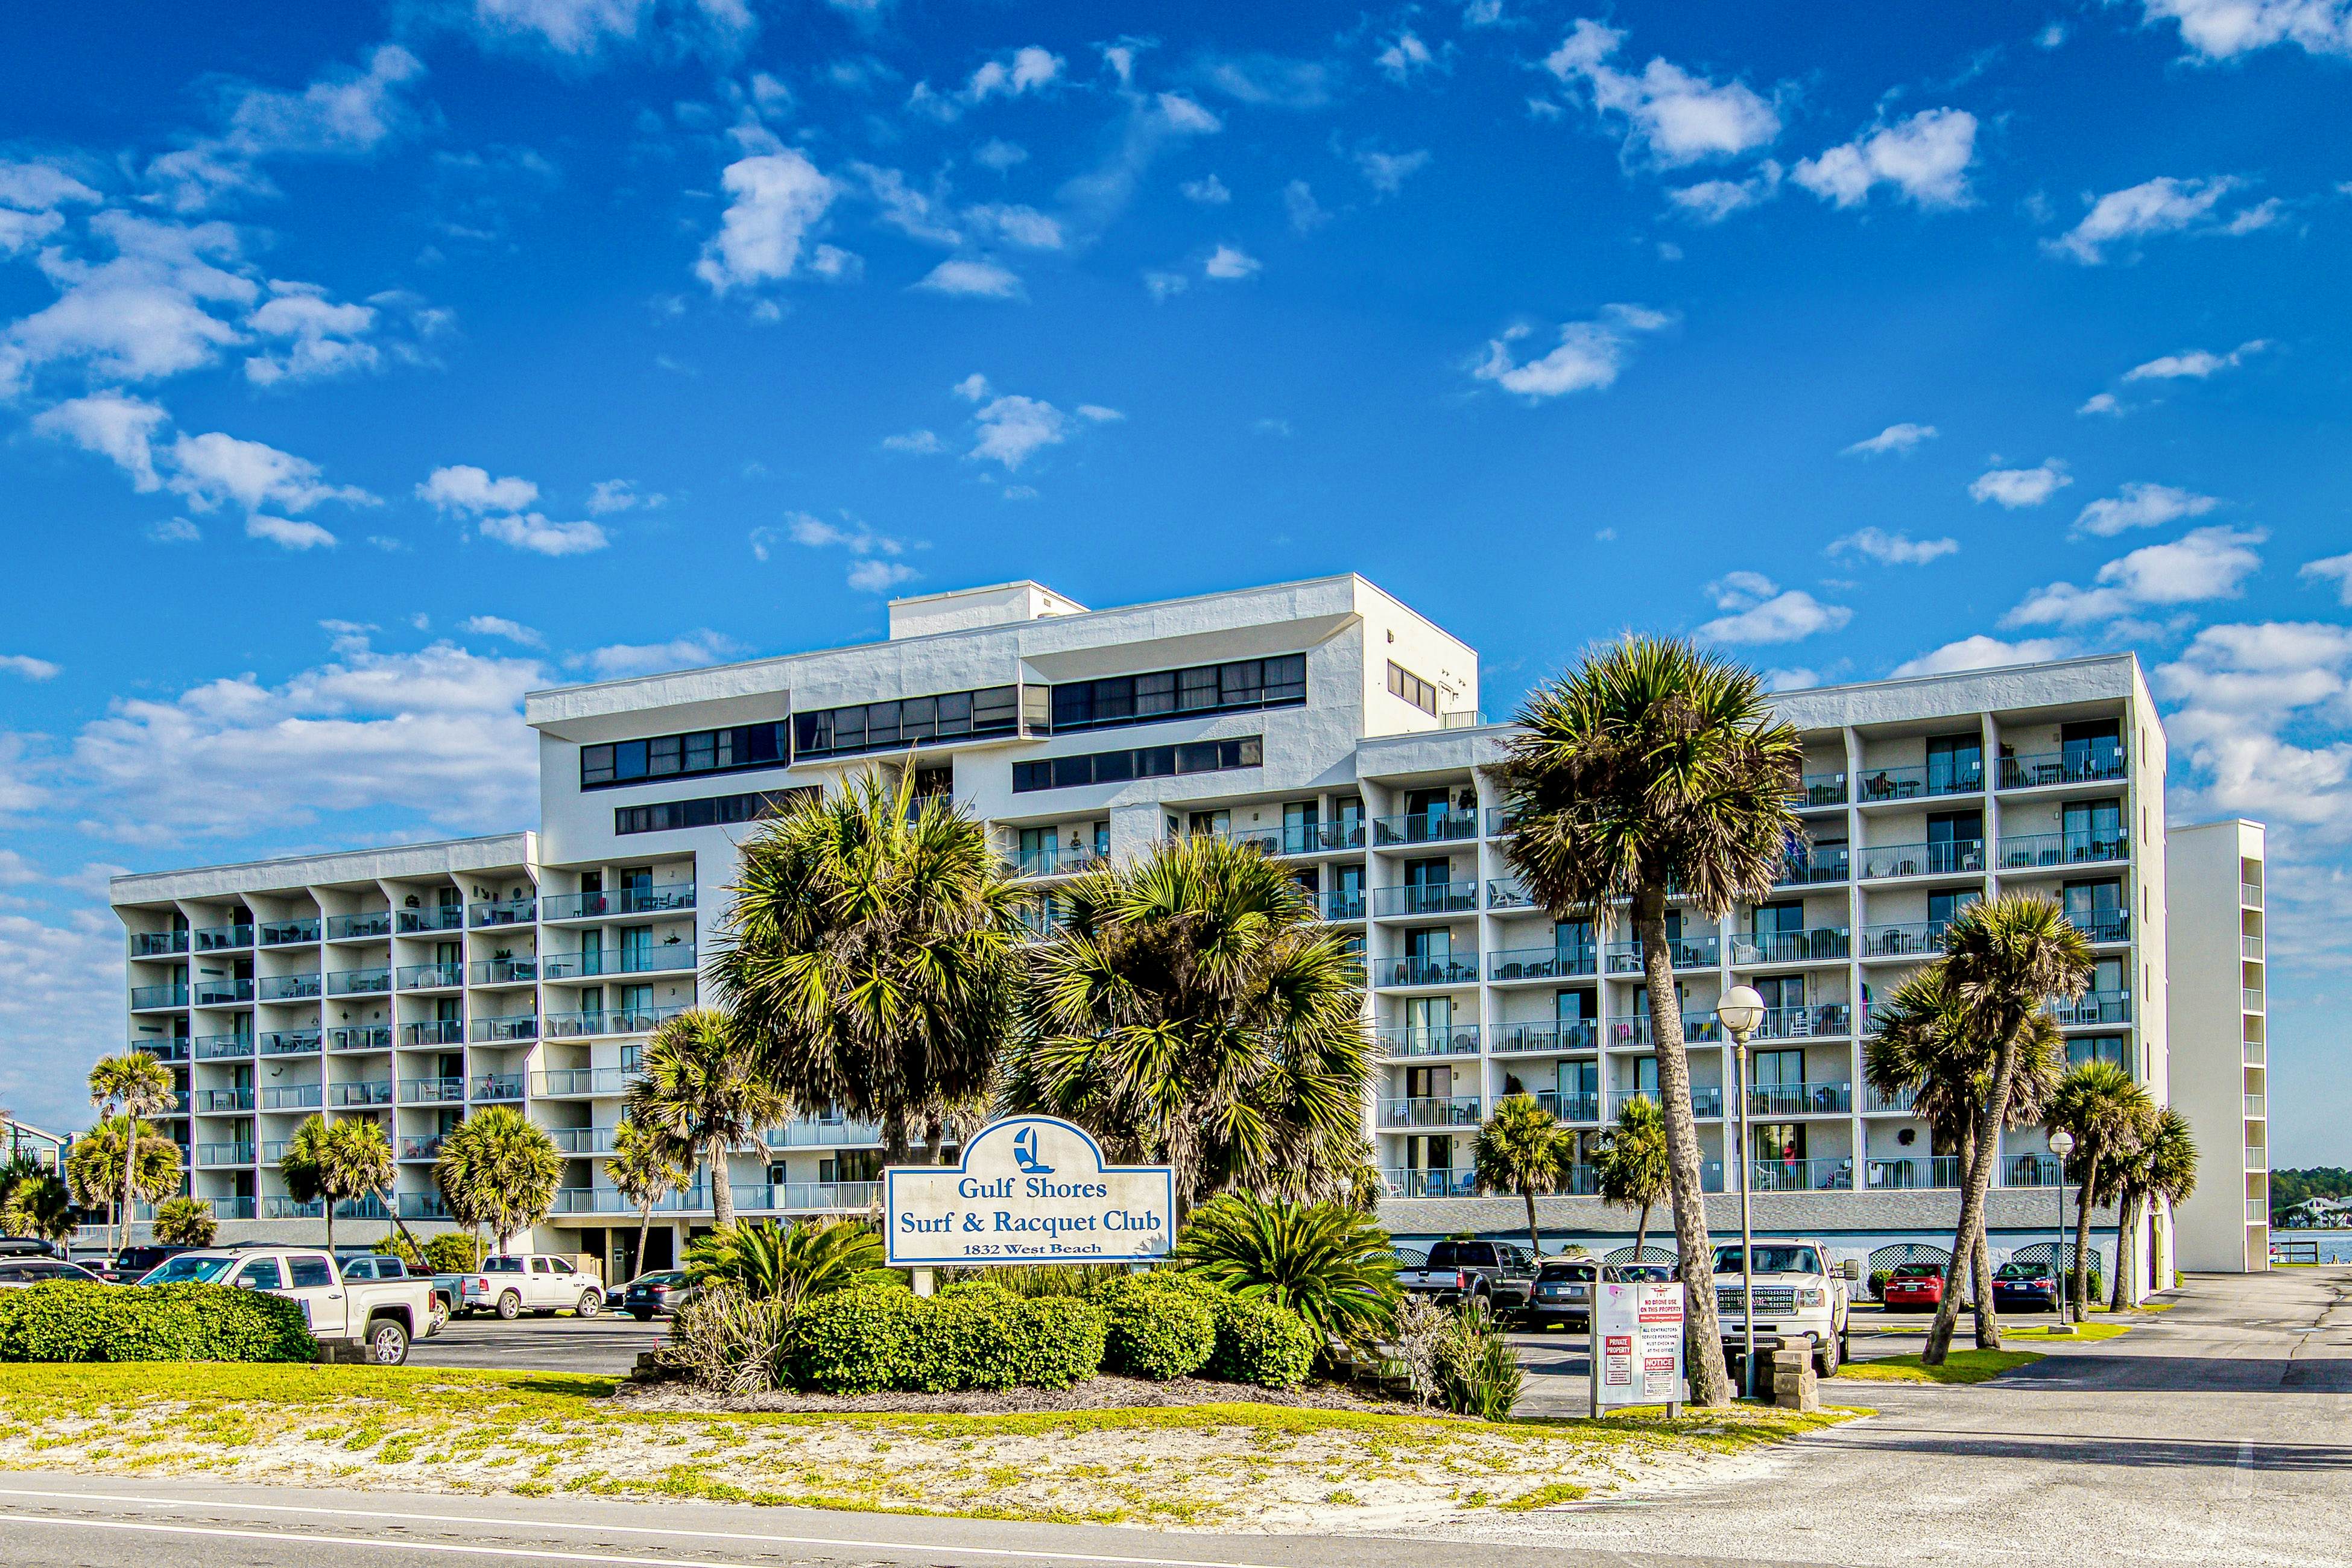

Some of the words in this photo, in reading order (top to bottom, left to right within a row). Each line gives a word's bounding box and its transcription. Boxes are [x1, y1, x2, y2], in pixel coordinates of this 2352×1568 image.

[958, 1177, 1016, 1198] Gulf
[1026, 1177, 1107, 1198] Shores
[901, 1212, 955, 1233] Surf
[963, 1213, 985, 1231] &
[993, 1211, 1096, 1238] Racquet
[1103, 1210, 1161, 1230] Club
[963, 1245, 1000, 1255] 1832
[1004, 1244, 1045, 1254] West
[1049, 1244, 1102, 1254] Beach
